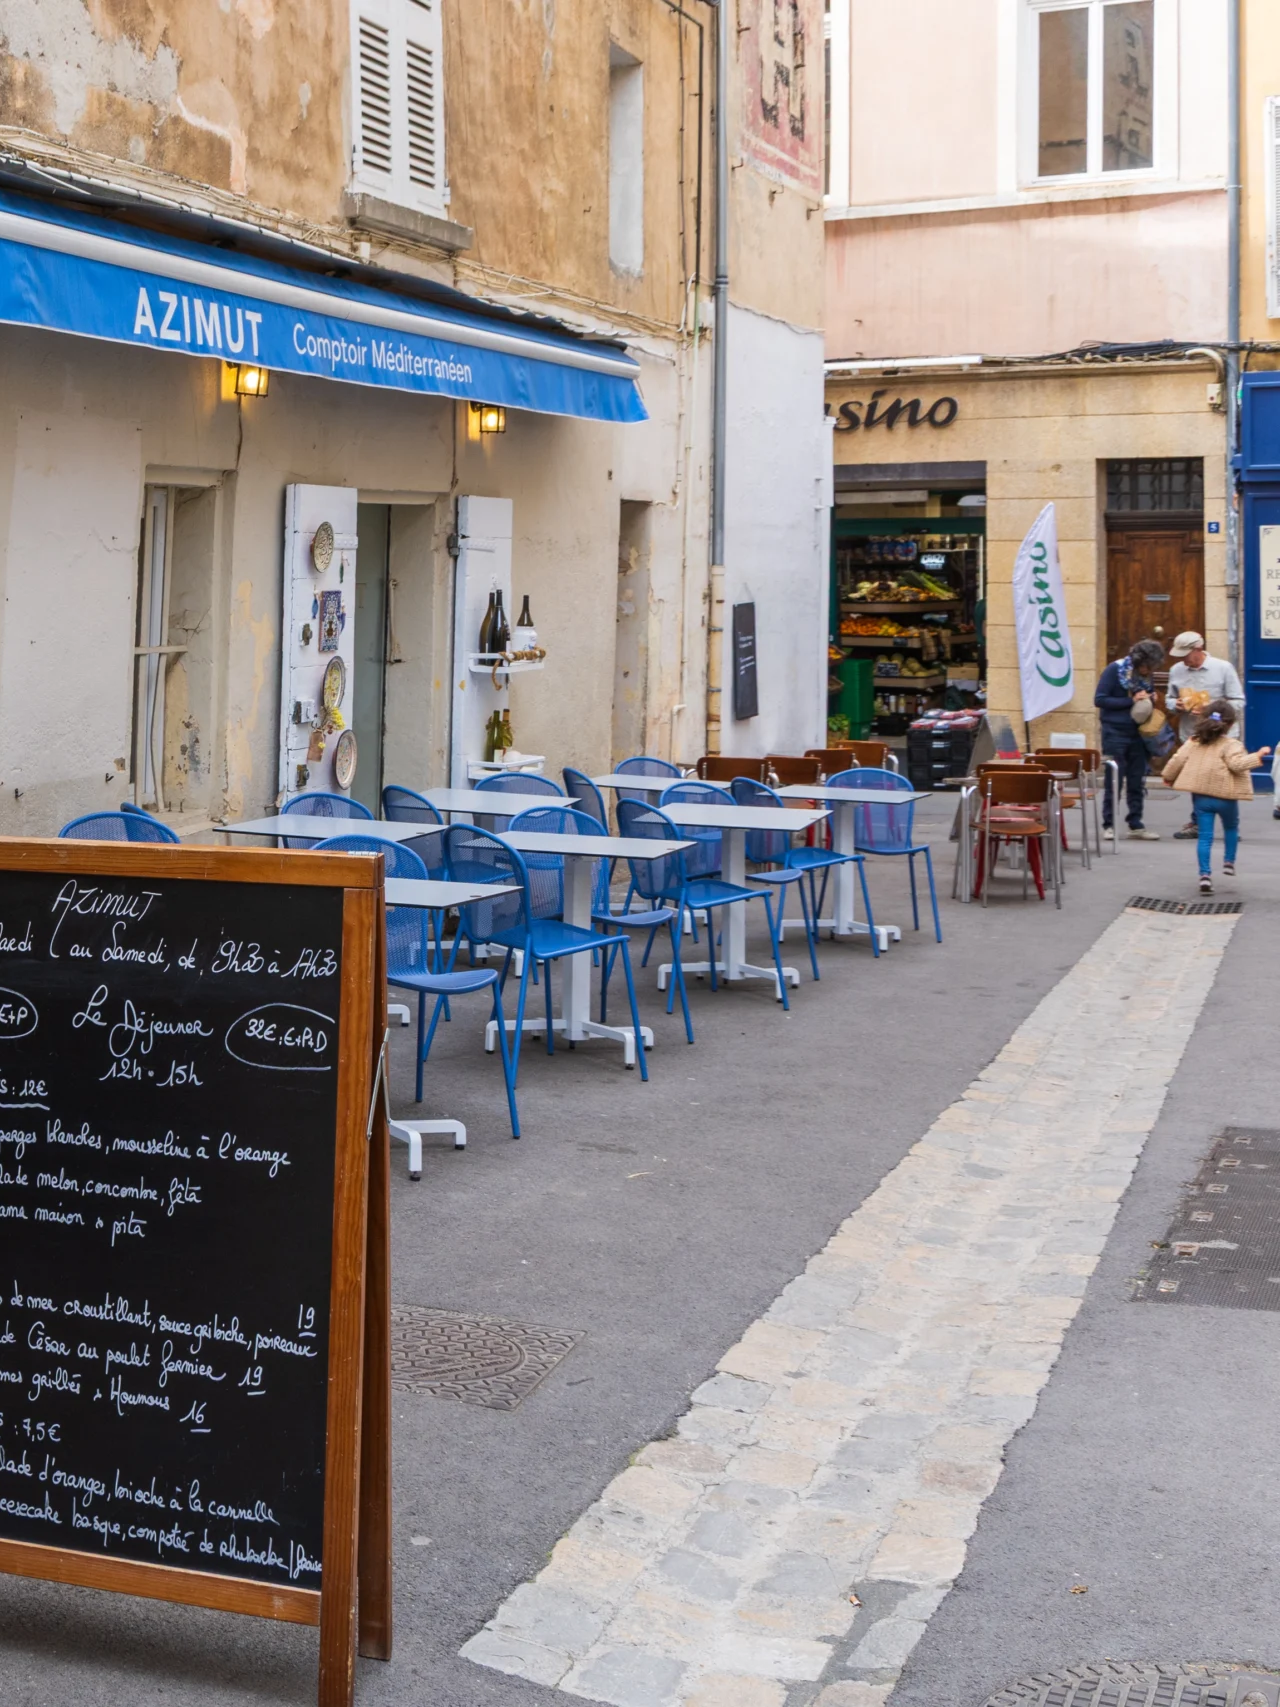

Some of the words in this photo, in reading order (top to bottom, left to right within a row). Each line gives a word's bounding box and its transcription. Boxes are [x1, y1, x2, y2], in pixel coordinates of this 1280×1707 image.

[133, 287, 263, 356] AZIMUT
[293, 322, 368, 371] Comptoir
[371, 340, 473, 384] Méditerranéen
[824, 390, 958, 432] sino
[1028, 541, 1072, 687] Casino
[69, 944, 93, 958] au
[212, 940, 265, 973] 9h30
[268, 950, 280, 973] à
[281, 947, 338, 980] 17h30
[72, 984, 109, 1028] Le
[109, 1000, 214, 1058] Déjeuner
[19, 1080, 49, 1097] 12€
[99, 1058, 142, 1081] 12h
[156, 1060, 204, 1087] 15h
[112, 1130, 192, 1158] mousseline
[196, 1135, 209, 1159] à
[219, 1132, 292, 1178] l'orange
[35, 1202, 85, 1226] maison
[111, 1211, 147, 1247] pita
[10, 1279, 24, 1307] de
[26, 1296, 58, 1313] mer
[158, 1314, 192, 1335] sauce
[253, 1328, 318, 1360] poireaux
[298, 1304, 316, 1330] 19
[28, 1321, 71, 1356] César
[77, 1343, 99, 1360] au
[105, 1342, 151, 1375] poulet
[158, 1339, 227, 1388] fermier
[238, 1366, 263, 1387] 19
[28, 1367, 82, 1402] grillés
[110, 1374, 171, 1416] Houmous
[179, 1400, 207, 1424] 16
[114, 1468, 166, 1508] brioche
[170, 1486, 183, 1511] à
[189, 1479, 204, 1513] la
[208, 1500, 281, 1526] cannelle
[199, 1528, 215, 1554] de
